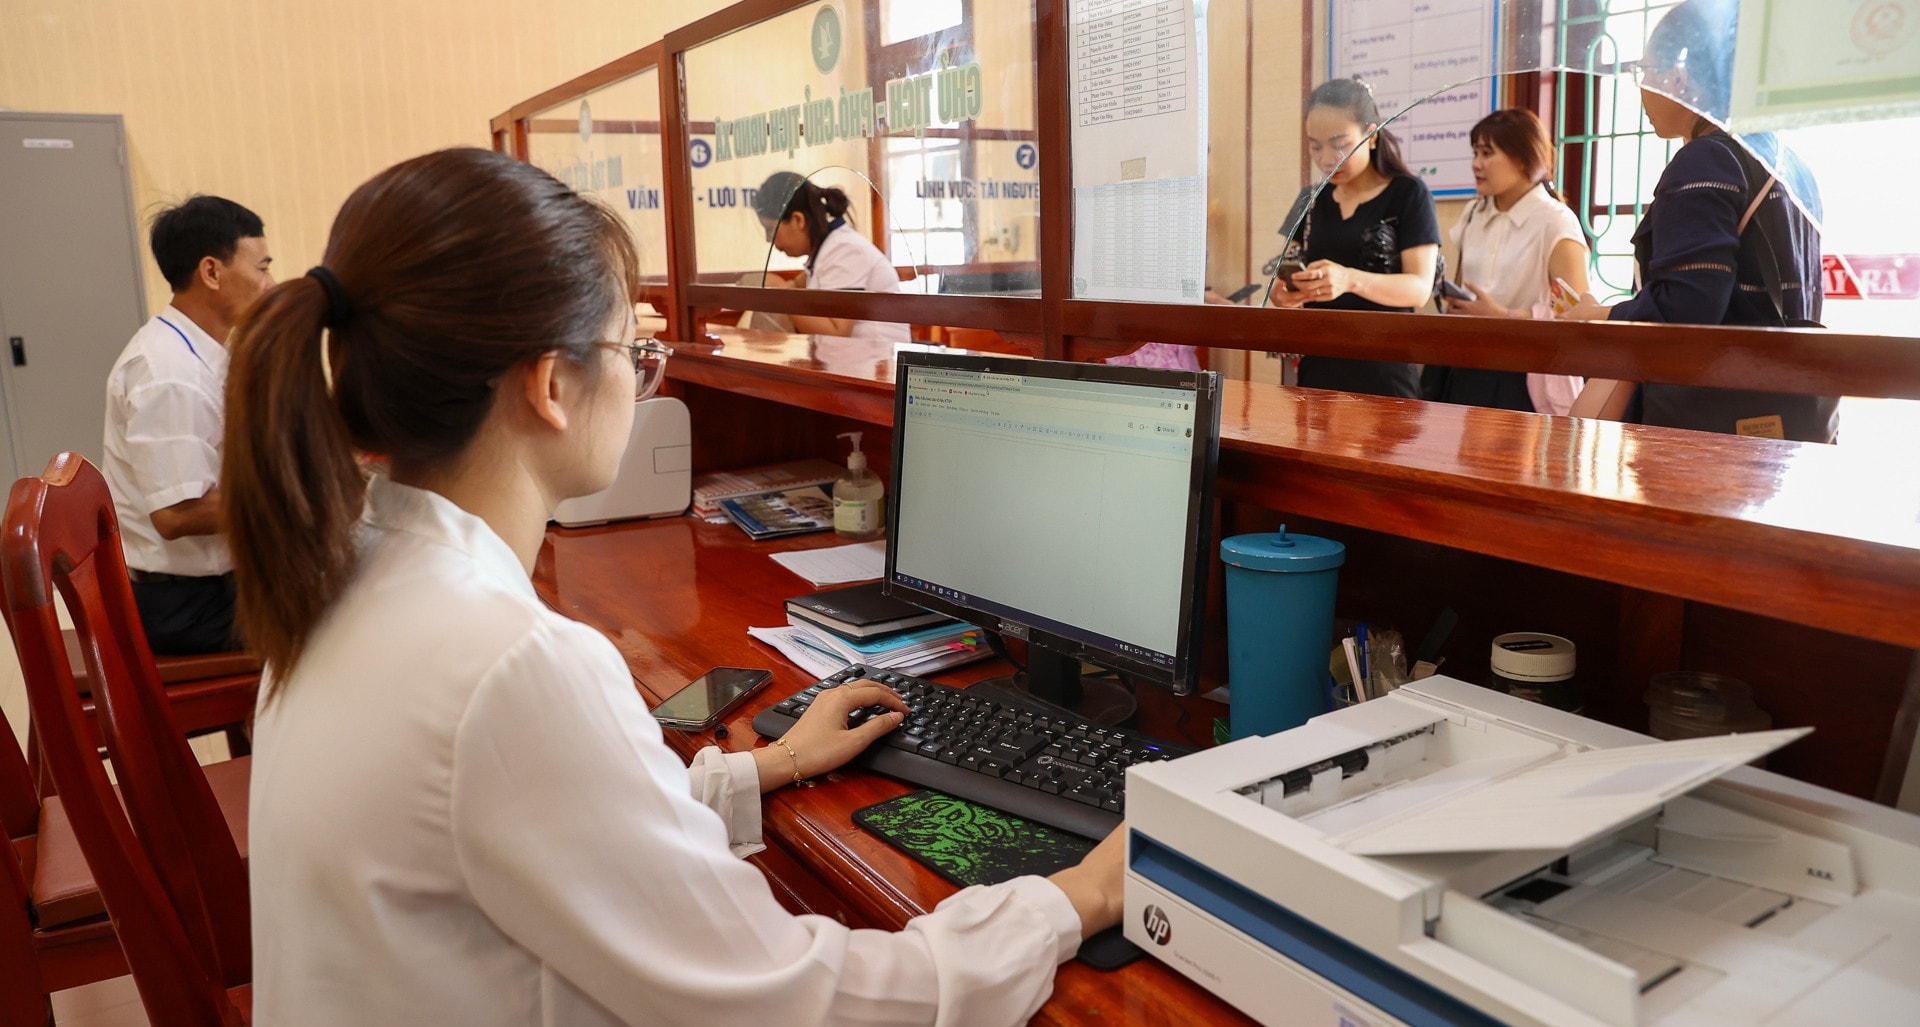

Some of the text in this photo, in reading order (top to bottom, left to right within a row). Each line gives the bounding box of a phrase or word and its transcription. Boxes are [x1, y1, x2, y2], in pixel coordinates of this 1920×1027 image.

[742, 188, 759, 208] TR
[1861, 269, 1903, 293] RA
[1004, 623, 1023, 635] acer
[1145, 904, 1169, 946] hp
